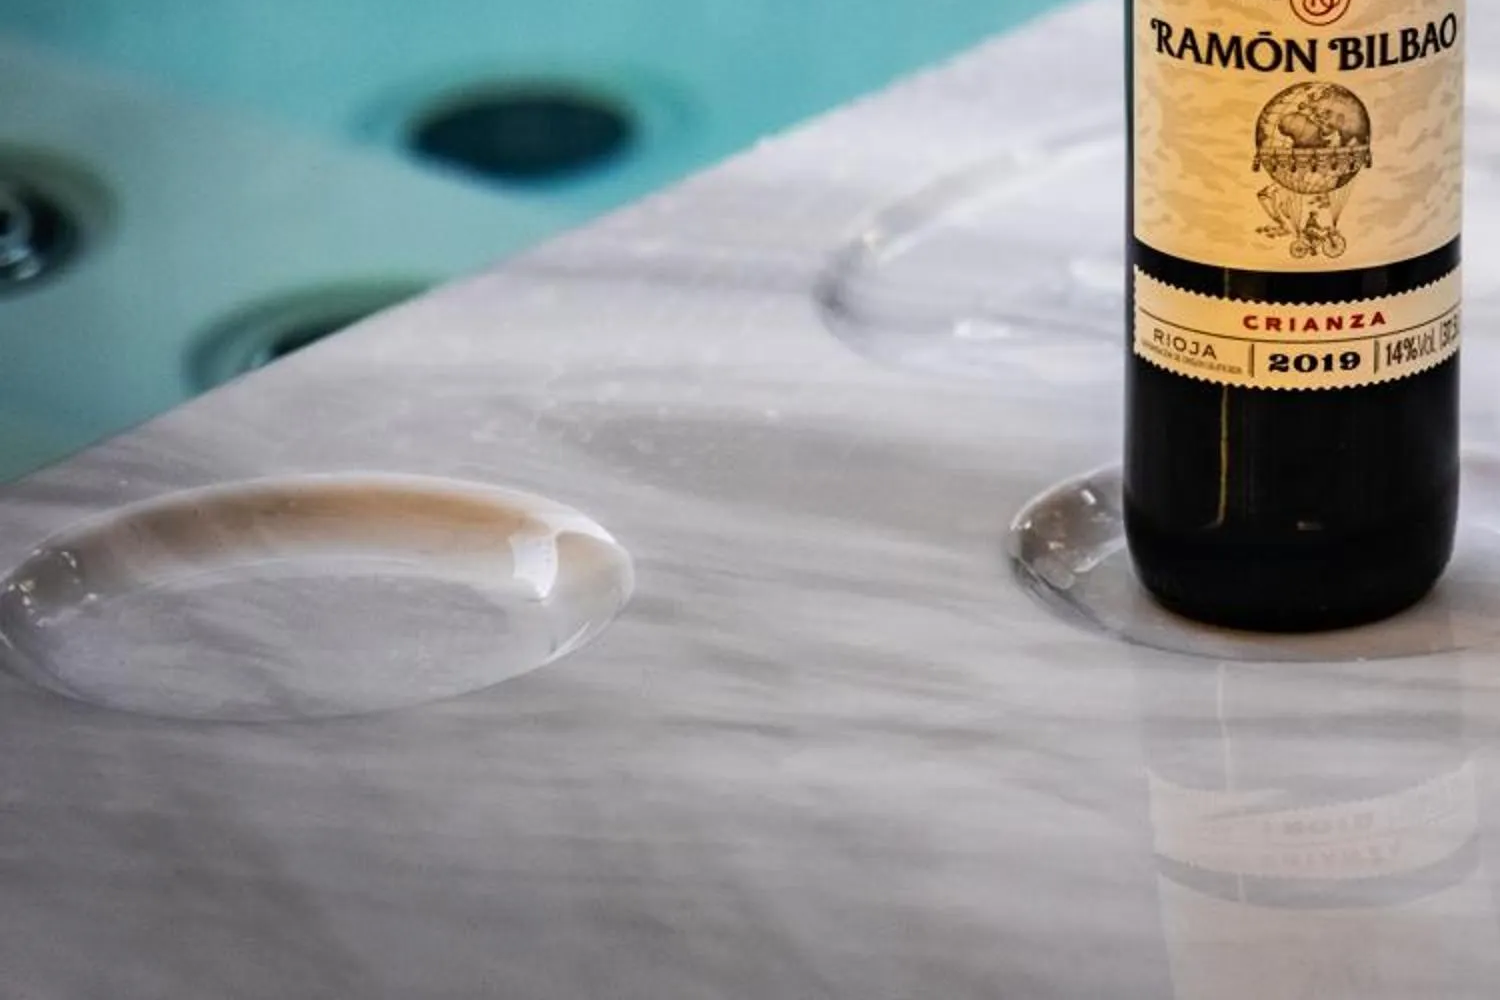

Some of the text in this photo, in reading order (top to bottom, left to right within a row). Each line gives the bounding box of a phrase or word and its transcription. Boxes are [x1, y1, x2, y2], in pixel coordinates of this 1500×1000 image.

[1151, 12, 1457, 73] RAMÓN BILBAO
[1242, 310, 1388, 333] CRIANZA
[1153, 328, 1217, 360] RIOJA
[1268, 351, 1361, 374] 2019
